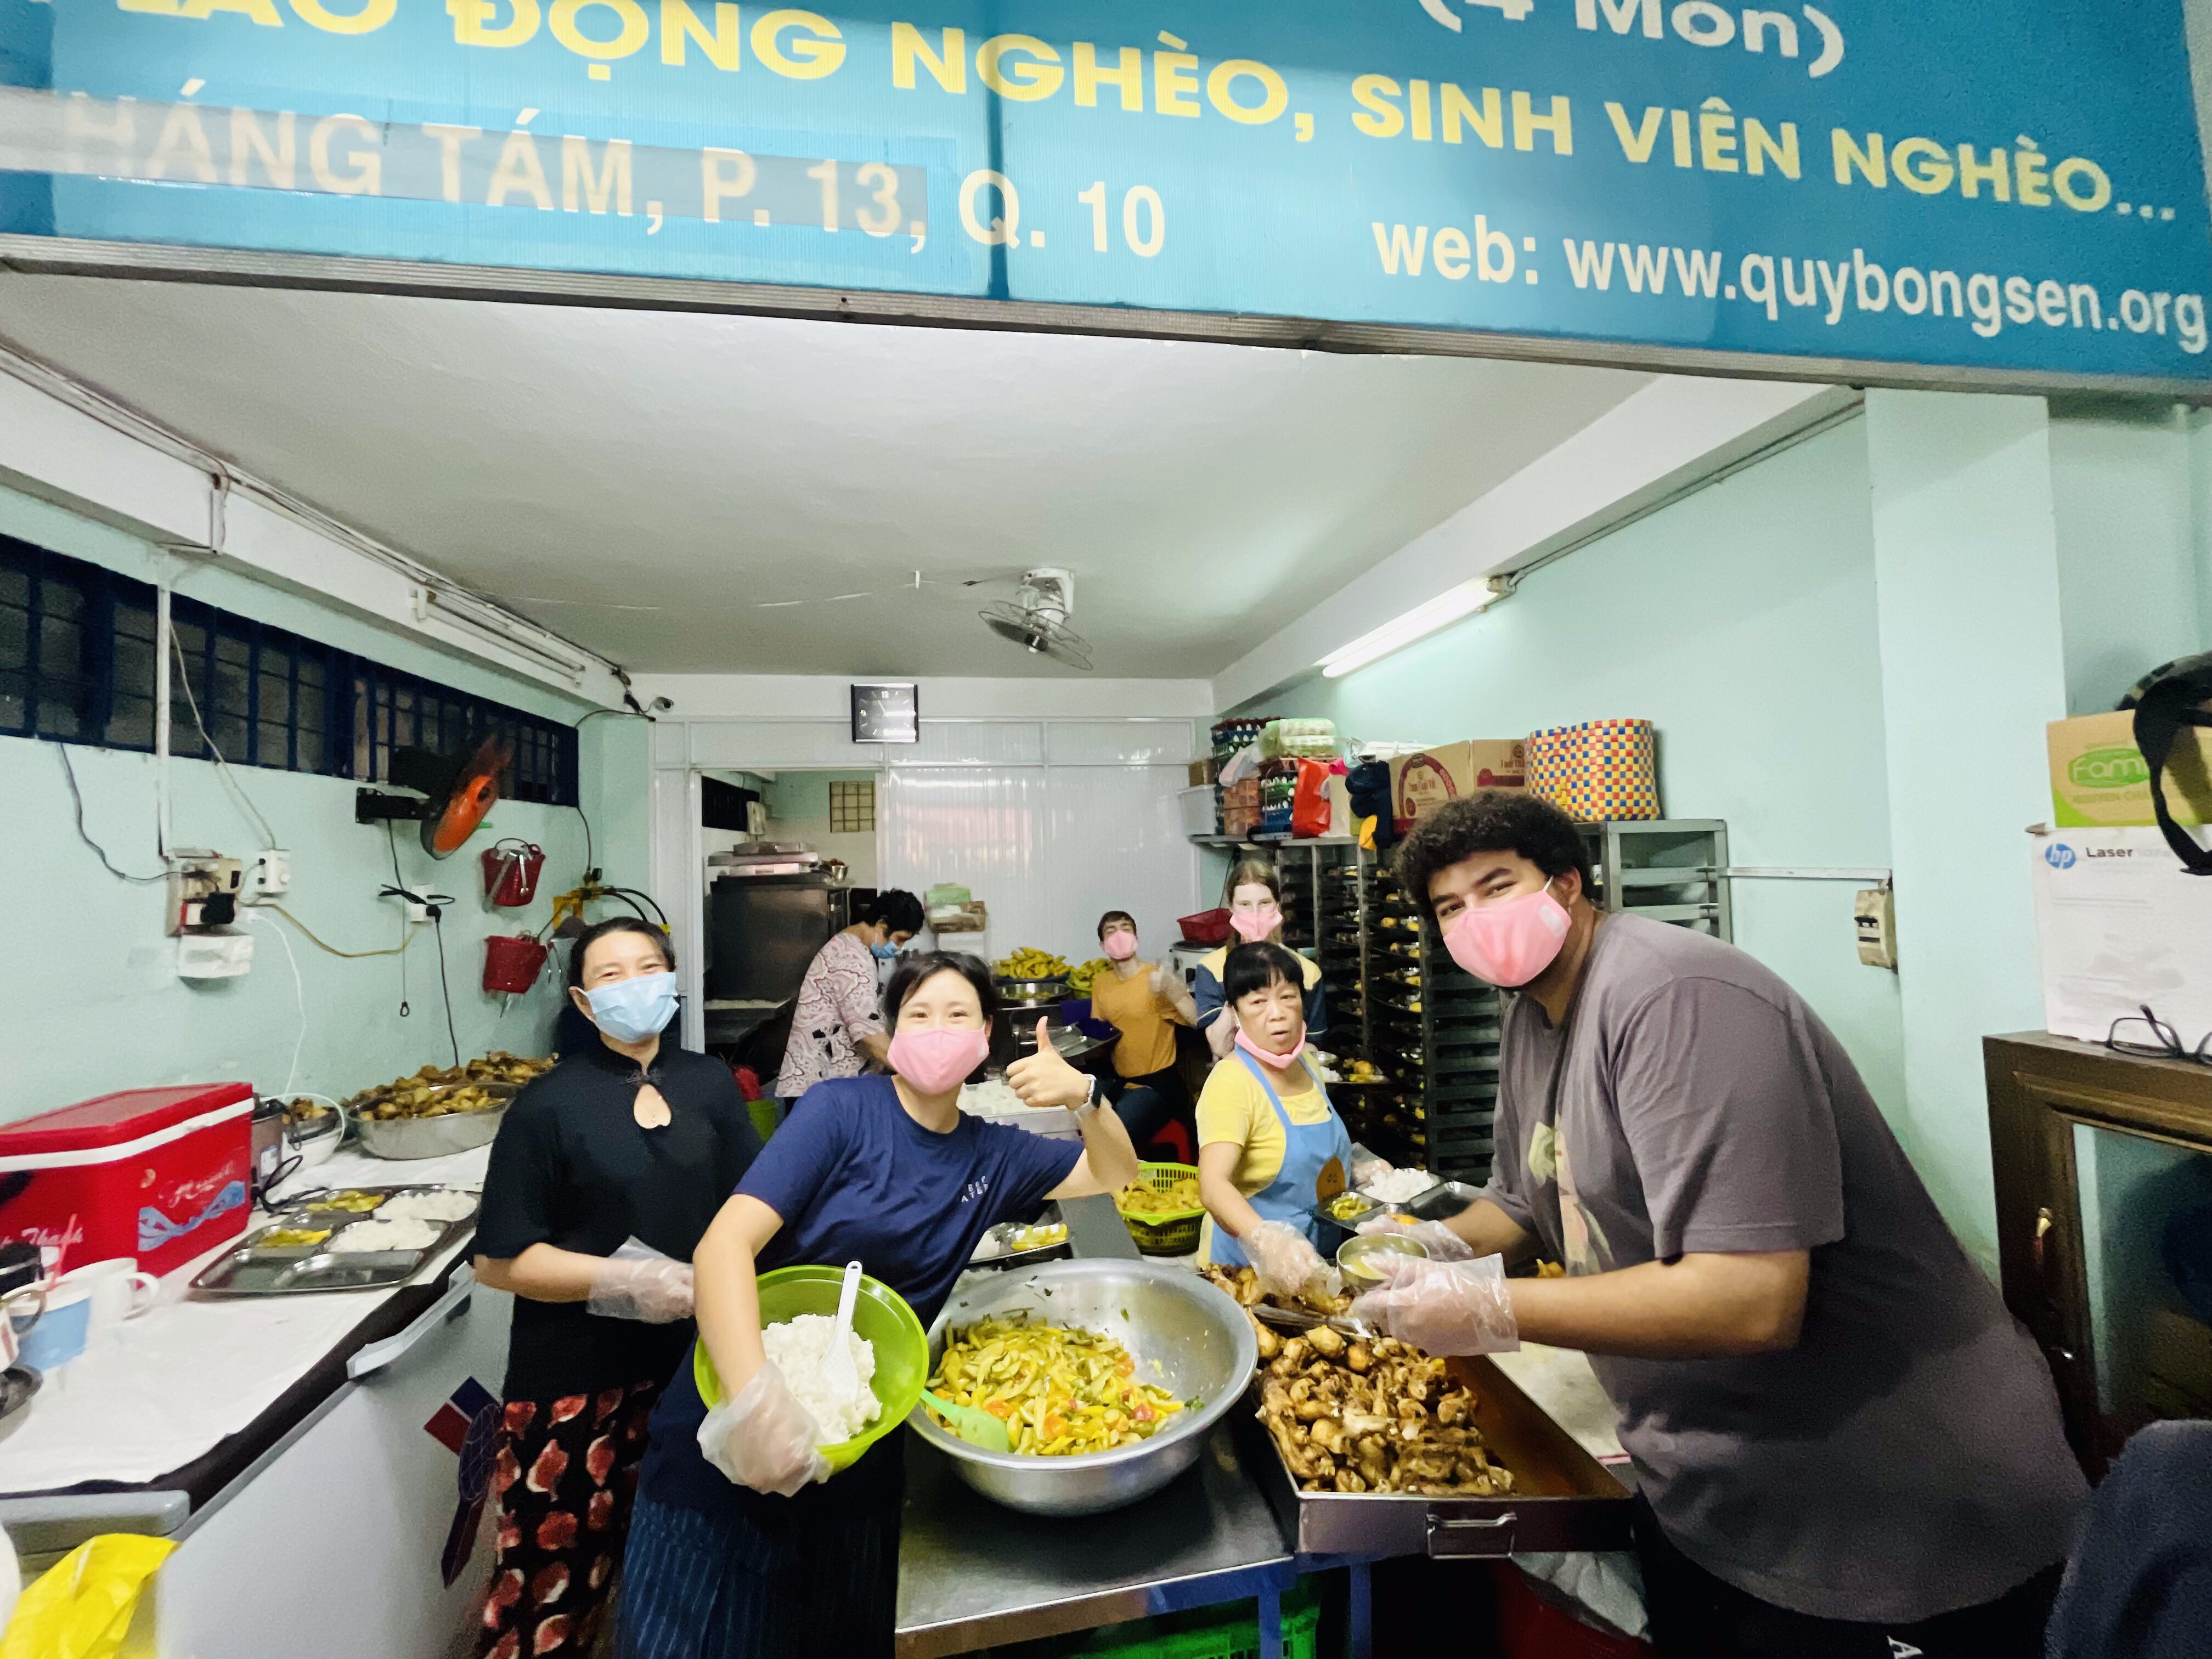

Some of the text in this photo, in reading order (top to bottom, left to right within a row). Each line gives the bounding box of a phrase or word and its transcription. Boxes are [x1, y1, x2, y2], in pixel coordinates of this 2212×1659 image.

[892, 22, 1313, 142] NGHÈO,
[1351, 75, 1572, 155] SINH
[1605, 98, 1800, 178] VIÊN
[1832, 129, 2176, 221] NGHÈO...
[421, 109, 662, 234] TÁM,
[702, 146, 769, 226] P.
[808, 159, 927, 254] 13,
[960, 170, 1045, 249] Q.
[1079, 182, 1165, 257] 10
[1373, 215, 2207, 353] web: www.quybongsen.org
[881, 690, 889, 698] 12
[2048, 843, 2074, 869] hp
[2085, 847, 2133, 858] Laser
